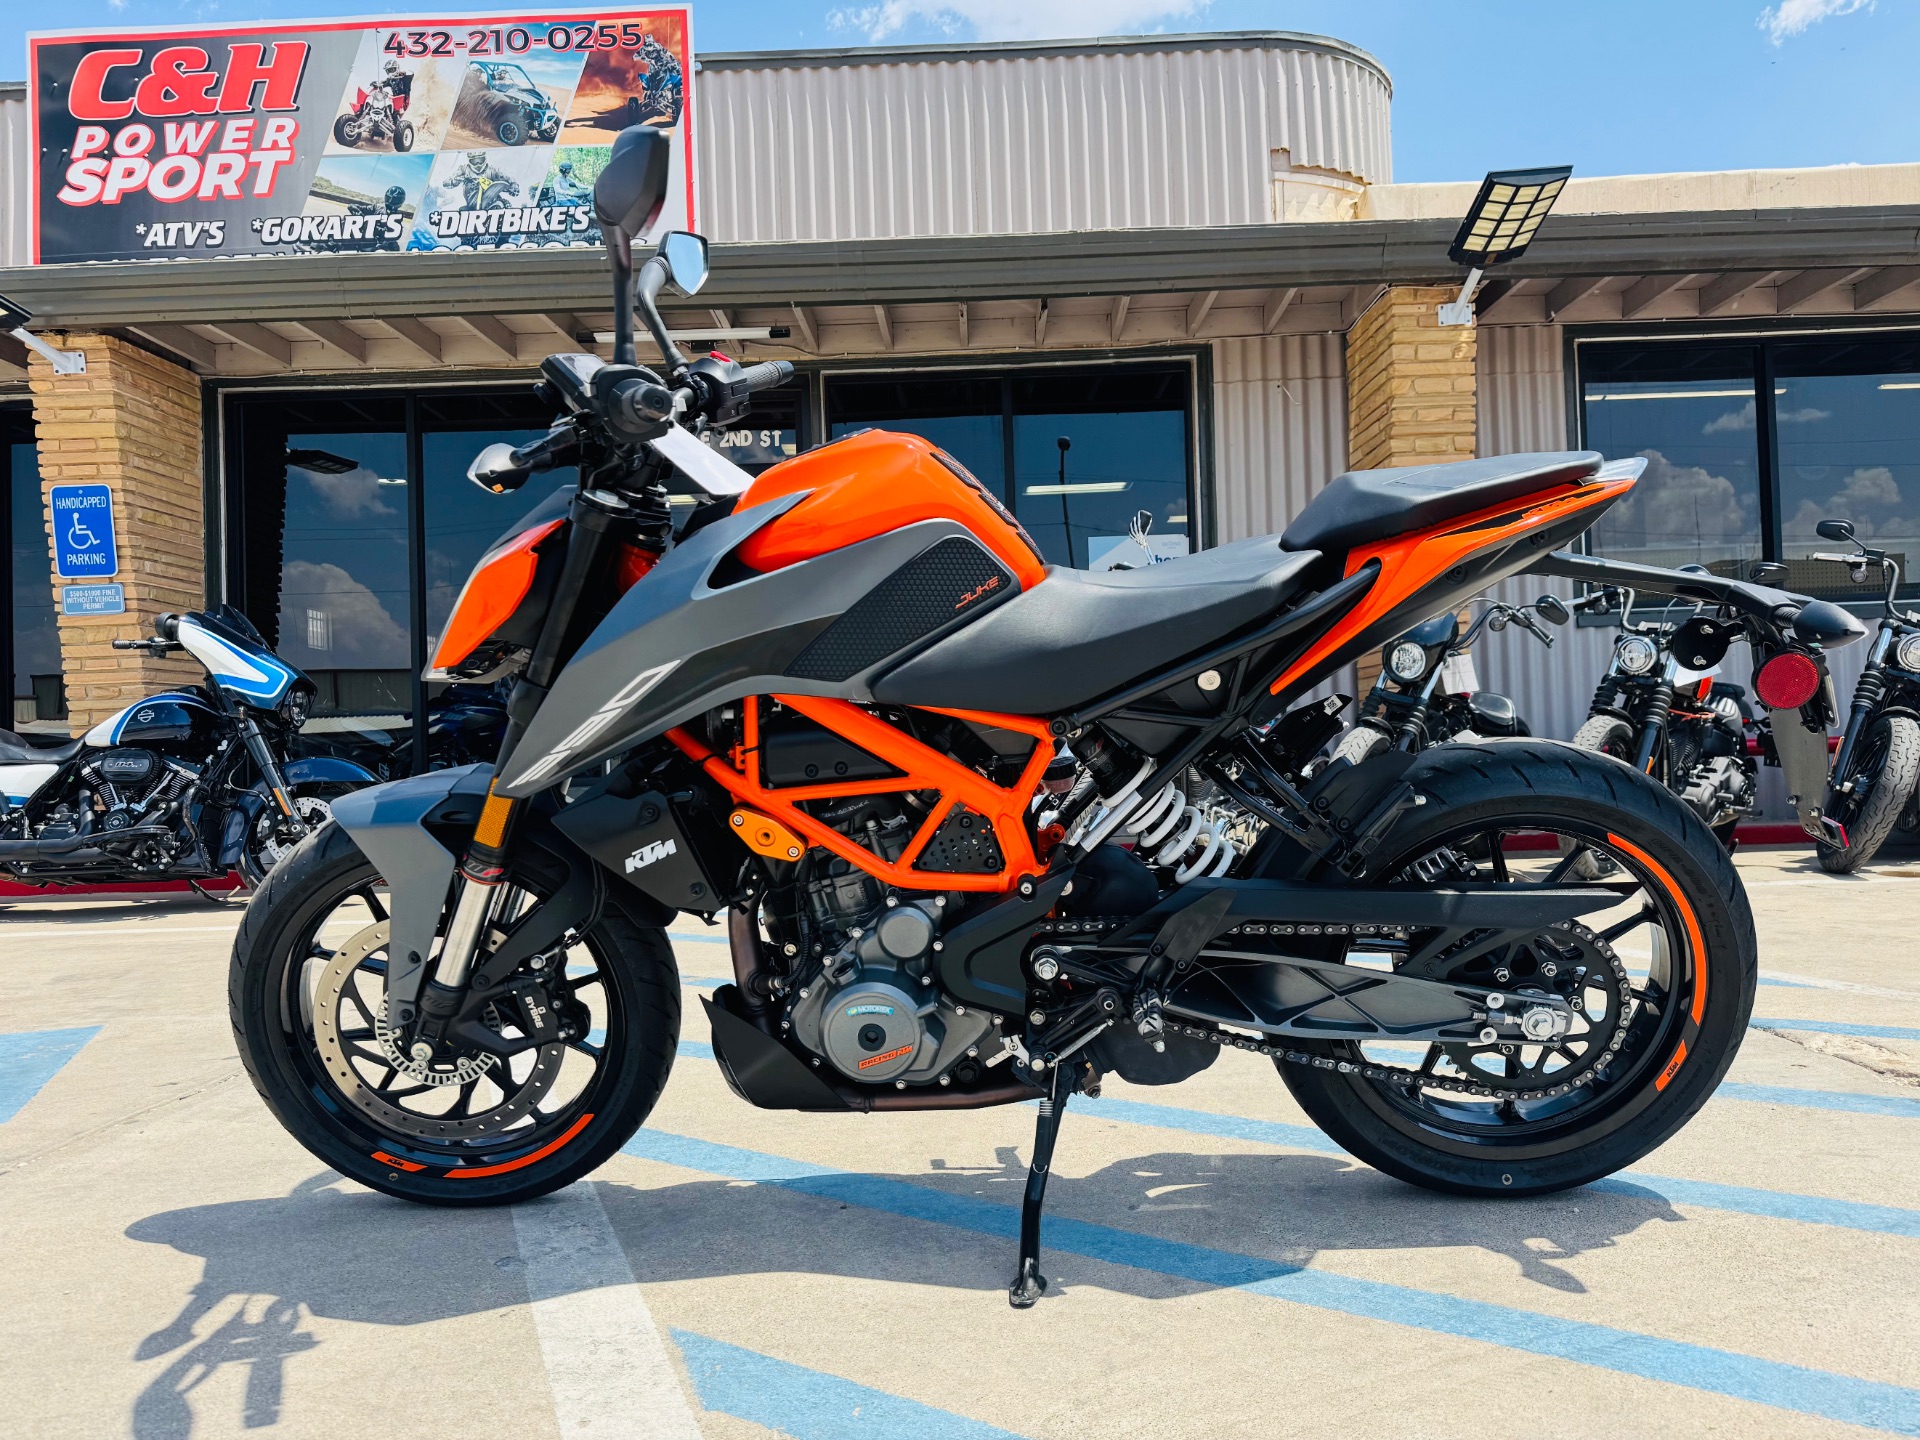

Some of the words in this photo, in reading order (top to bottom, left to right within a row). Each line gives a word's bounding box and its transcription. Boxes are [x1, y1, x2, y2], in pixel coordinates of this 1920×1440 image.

[383, 23, 644, 58] 432-210-0255
[68, 41, 310, 121] C&H
[70, 117, 300, 162] POWER
[56, 150, 296, 206] SPORT
[719, 429, 753, 448] 2ND
[759, 429, 782, 448] ST
[55, 496, 107, 509] HANDICAPPED
[67, 553, 106, 565] PARKING
[66, 596, 94, 604] WITHOUT
[102, 588, 116, 596] FINE
[82, 602, 105, 610] PERMIT
[624, 838, 677, 874] KTM
[524, 995, 544, 1029] BYBRE
[858, 1005, 890, 1014] MOTOREX
